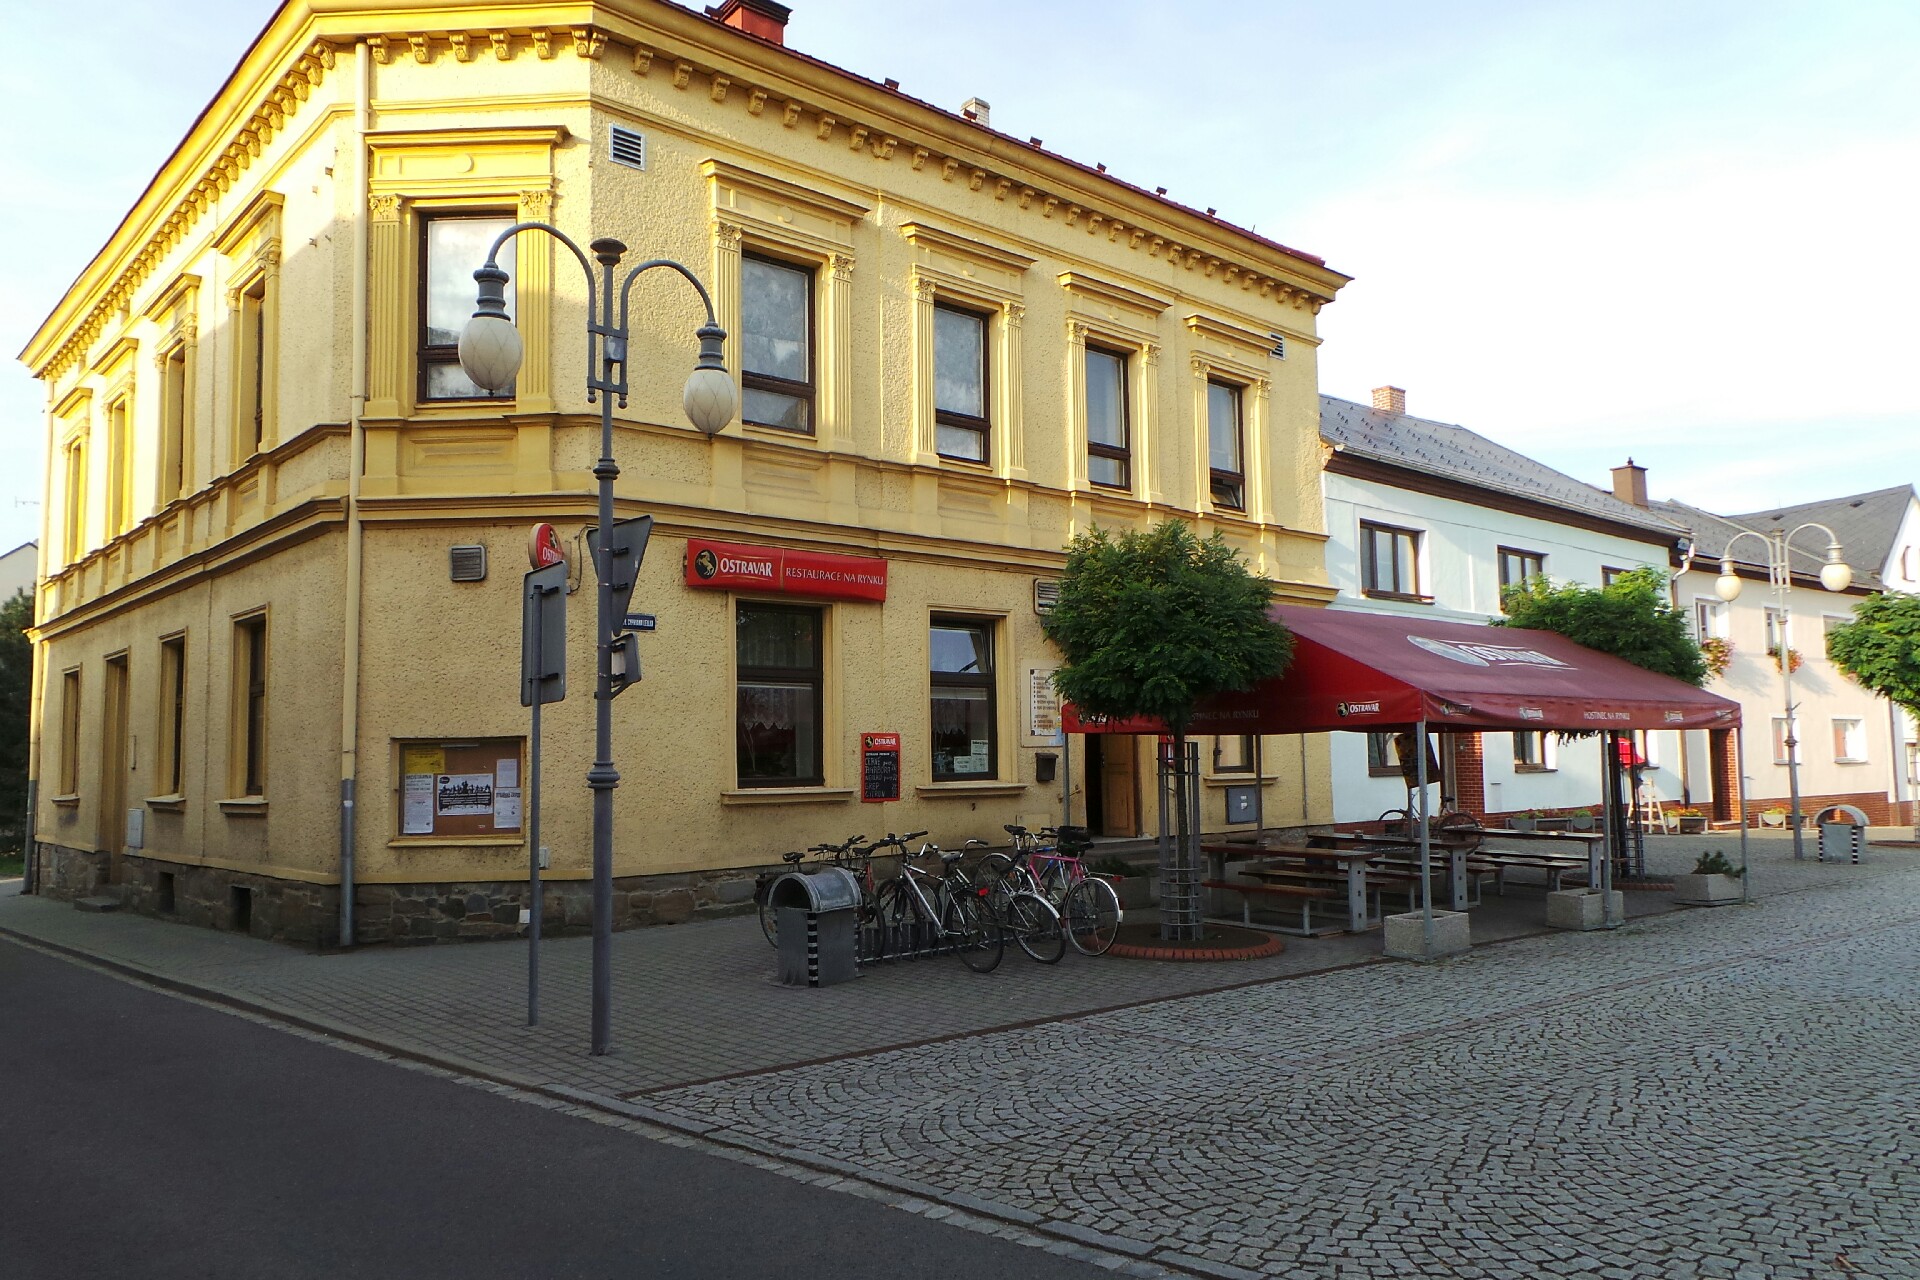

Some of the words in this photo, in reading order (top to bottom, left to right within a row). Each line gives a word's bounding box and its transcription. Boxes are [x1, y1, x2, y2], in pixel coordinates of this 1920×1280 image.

[720, 557, 773, 577] OSTRAVAR
[785, 567, 841, 581] RESTAURACE
[844, 572, 856, 582] NA
[857, 574, 884, 586] RYNKU
[1349, 702, 1380, 714] OSTRAVAR
[1220, 711, 1231, 720] NA
[1232, 710, 1258, 719] RYNKU
[1584, 711, 1606, 720] HOSTINEC
